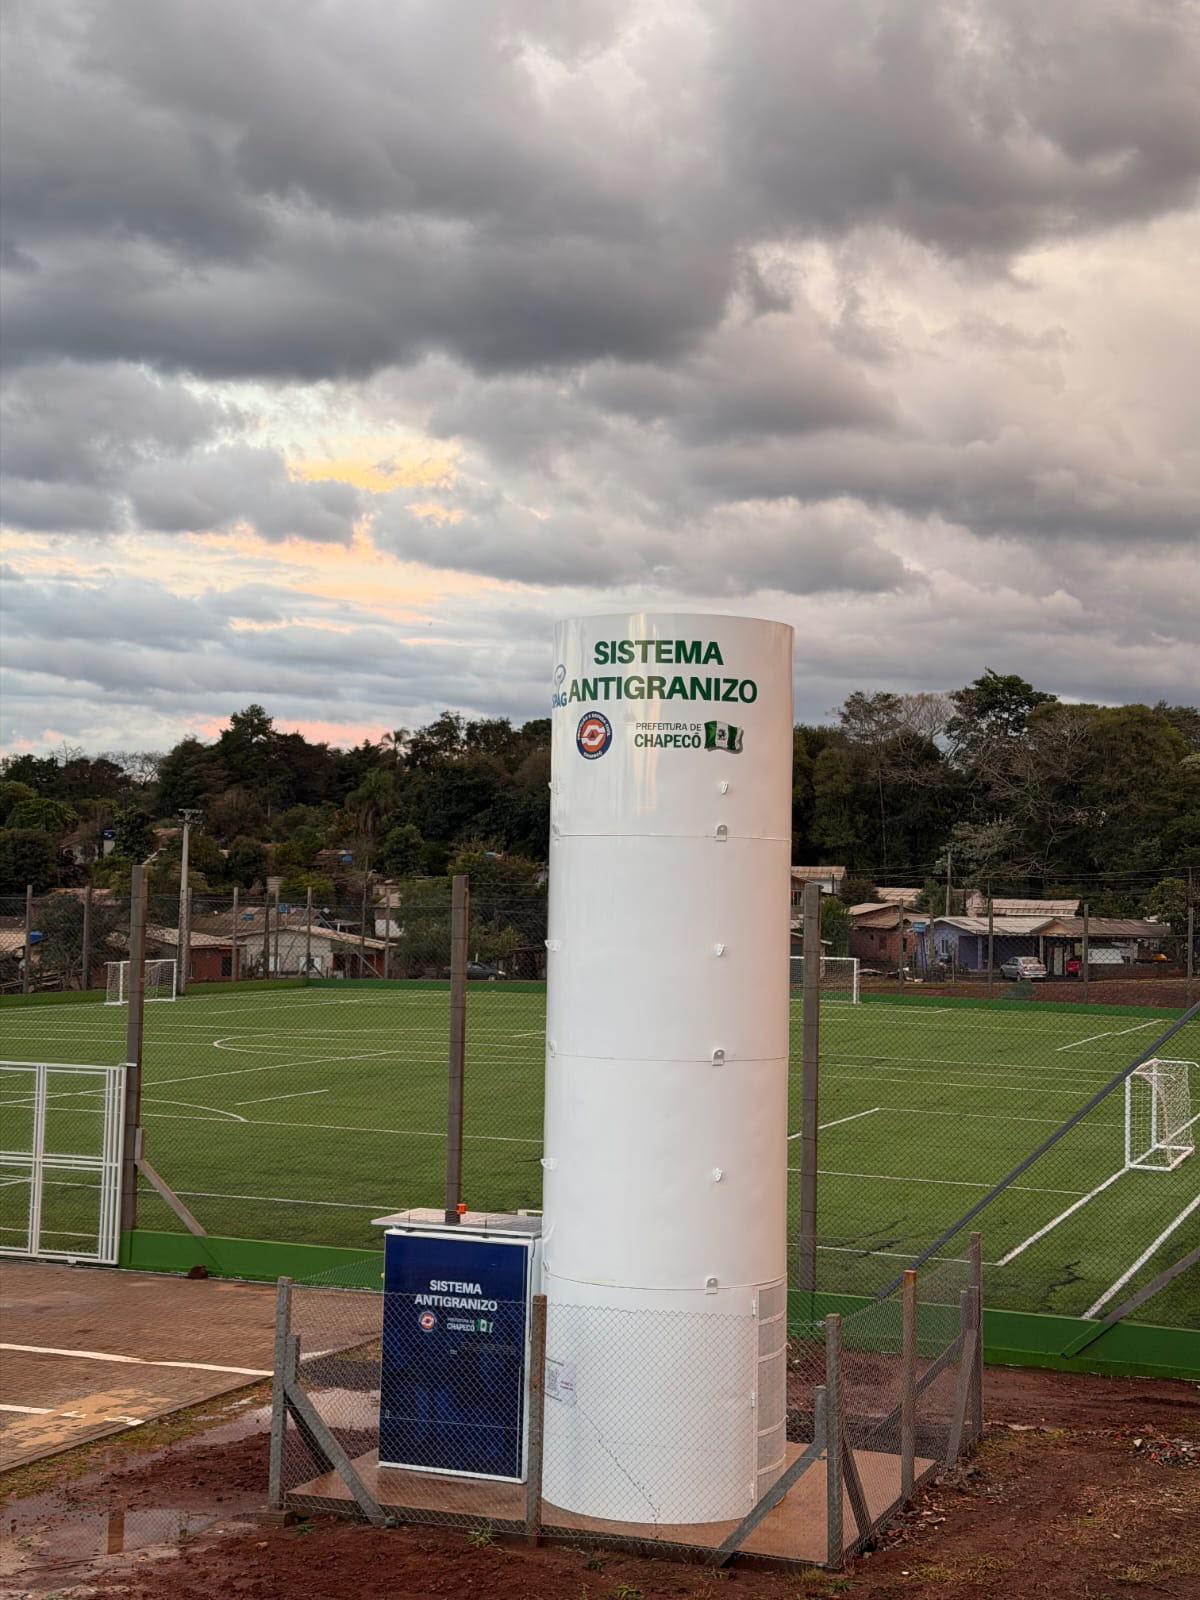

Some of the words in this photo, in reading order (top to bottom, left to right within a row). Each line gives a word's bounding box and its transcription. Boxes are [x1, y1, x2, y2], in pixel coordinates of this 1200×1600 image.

[593, 640, 724, 665] SISTEMA
[568, 676, 758, 704] ANTIGRANIZO
[635, 722, 688, 731] PREFEITURA
[690, 723, 702, 731] DE
[429, 1279, 482, 1295] SISTEMA
[414, 1294, 498, 1311] ANTIGRANIZO
